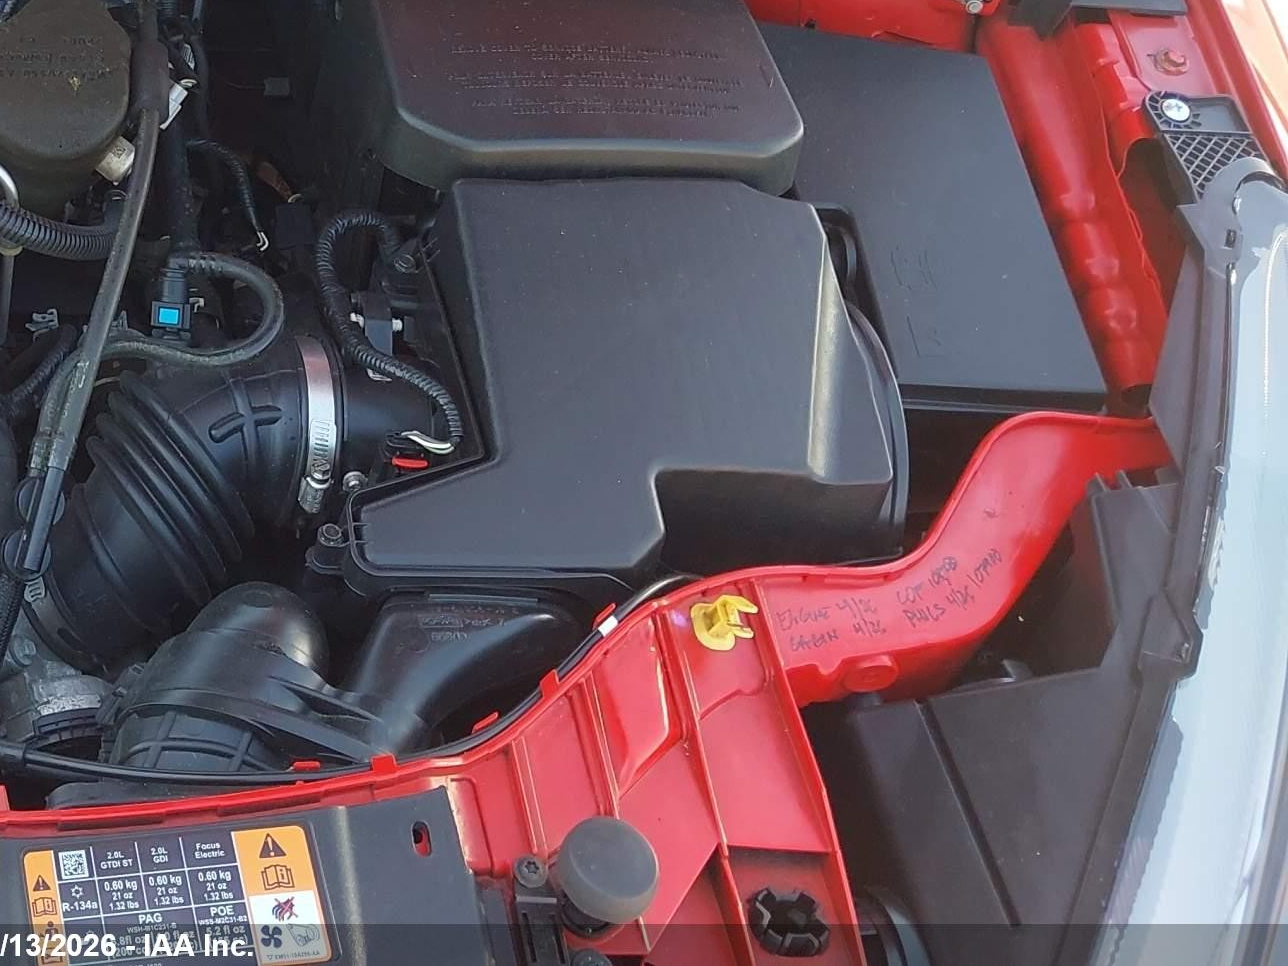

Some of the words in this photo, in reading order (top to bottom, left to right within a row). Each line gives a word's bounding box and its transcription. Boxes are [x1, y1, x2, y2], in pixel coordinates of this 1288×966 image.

[150, 847, 168, 855] 2.0L
[196, 841, 221, 852] Focus
[106, 851, 124, 860] 2.0L
[153, 855, 169, 864] GDI
[194, 849, 226, 860] Electric
[100, 861, 121, 870] GTDI
[122, 858, 134, 867] ST
[148, 875, 168, 886] 0.60
[169, 873, 183, 886] kg
[198, 872, 218, 882] 0.60
[219, 869, 232, 881] kg
[104, 880, 124, 892] 0.60
[125, 879, 138, 891] kg
[206, 883, 216, 891] 21
[217, 882, 228, 890] oz
[112, 893, 122, 901] 21
[156, 887, 166, 896] 21
[203, 893, 220, 902] 1.32
[221, 891, 234, 900] lbs
[62, 900, 98, 912] R-134a
[109, 902, 126, 911] 1.32
[126, 900, 140, 909] lbs
[154, 897, 171, 906] 1.32
[172, 895, 185, 904] lbs
[210, 905, 235, 916] POE
[138, 913, 163, 924] PAG
